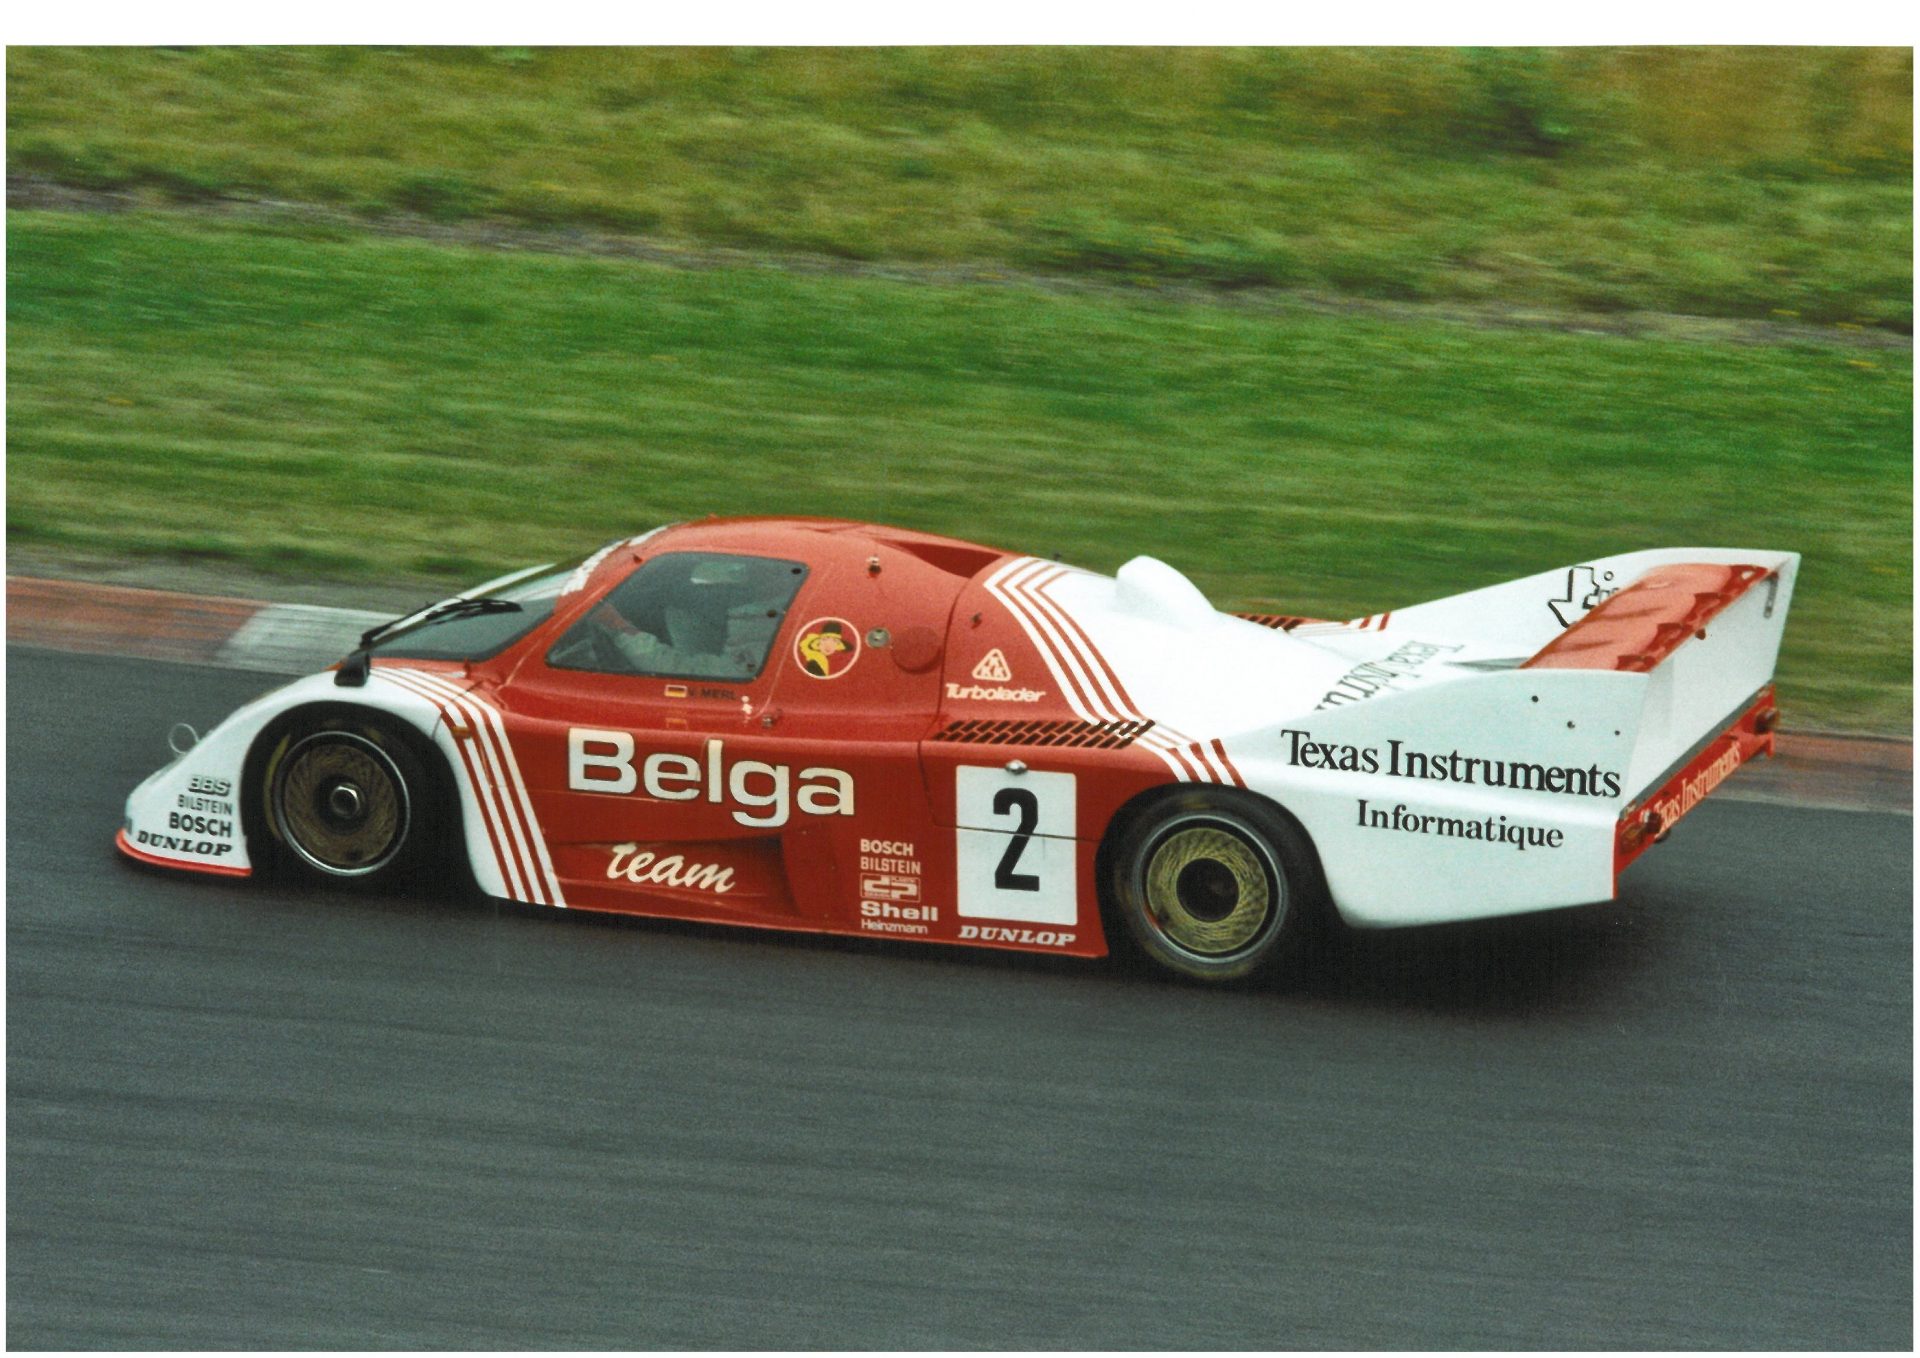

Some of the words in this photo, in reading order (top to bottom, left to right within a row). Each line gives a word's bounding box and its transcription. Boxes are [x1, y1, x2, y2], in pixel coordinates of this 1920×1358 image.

[945, 682, 1046, 702] Turbolader
[1281, 729, 1379, 774] Texas
[1386, 739, 1621, 798] Instruments
[188, 776, 231, 797] BBS
[568, 727, 855, 827] Belga
[178, 794, 233, 815] BILSTEIN
[169, 811, 232, 838] BOSCH
[1358, 799, 1564, 850] Informatique
[137, 830, 232, 856] DUNLOP
[860, 838, 914, 857] BOSCH
[993, 787, 1040, 892] 2
[606, 842, 736, 893] team
[860, 856, 921, 875] BILSTEIN
[861, 900, 938, 922] Shell
[861, 918, 928, 935] Heinzmann
[958, 925, 1077, 947] DUNLOP
